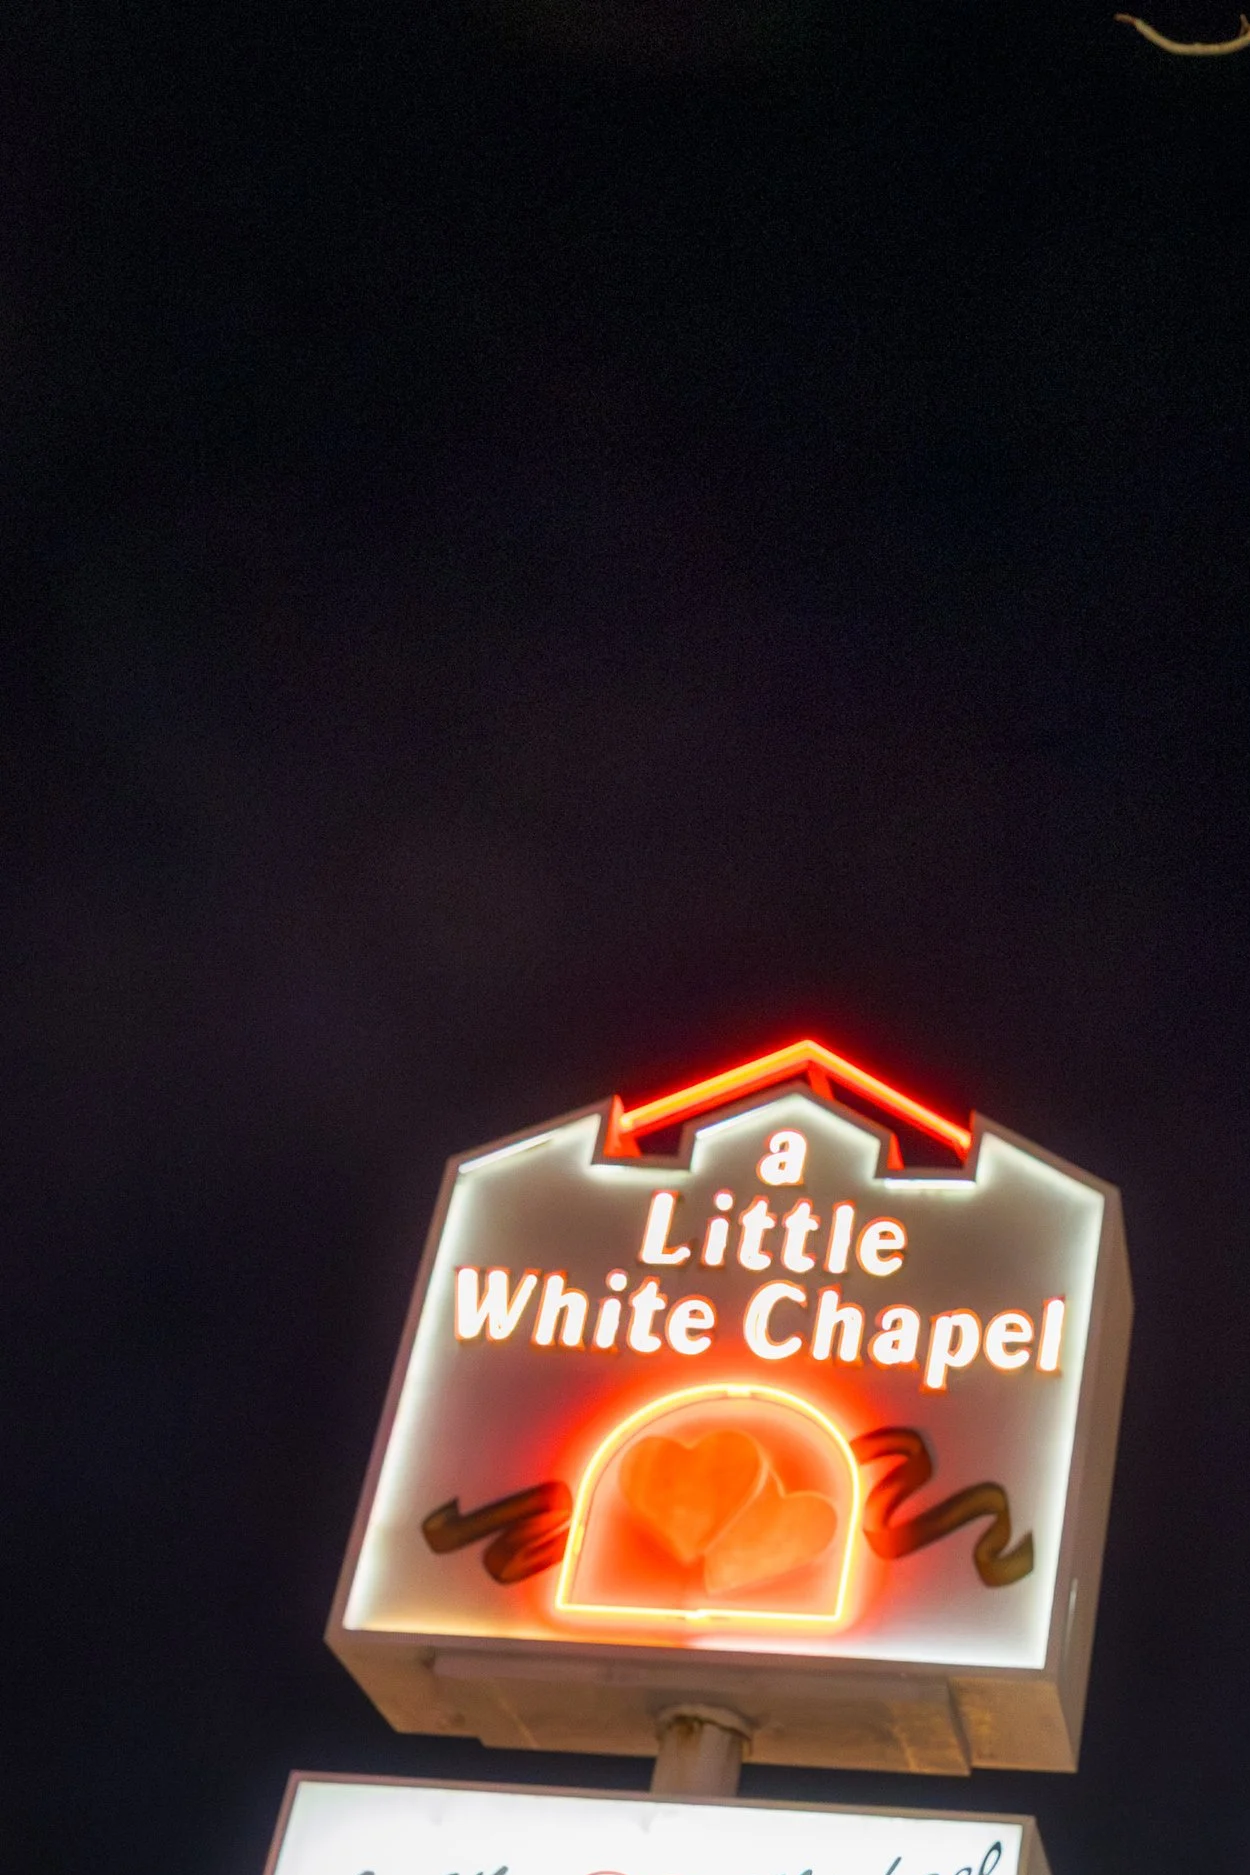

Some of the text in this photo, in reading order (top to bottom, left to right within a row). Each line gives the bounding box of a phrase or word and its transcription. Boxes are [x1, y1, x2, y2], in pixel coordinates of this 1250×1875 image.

[757, 1129, 808, 1186] a
[640, 1189, 906, 1277] Little
[454, 1266, 1065, 1390] White Chapel
